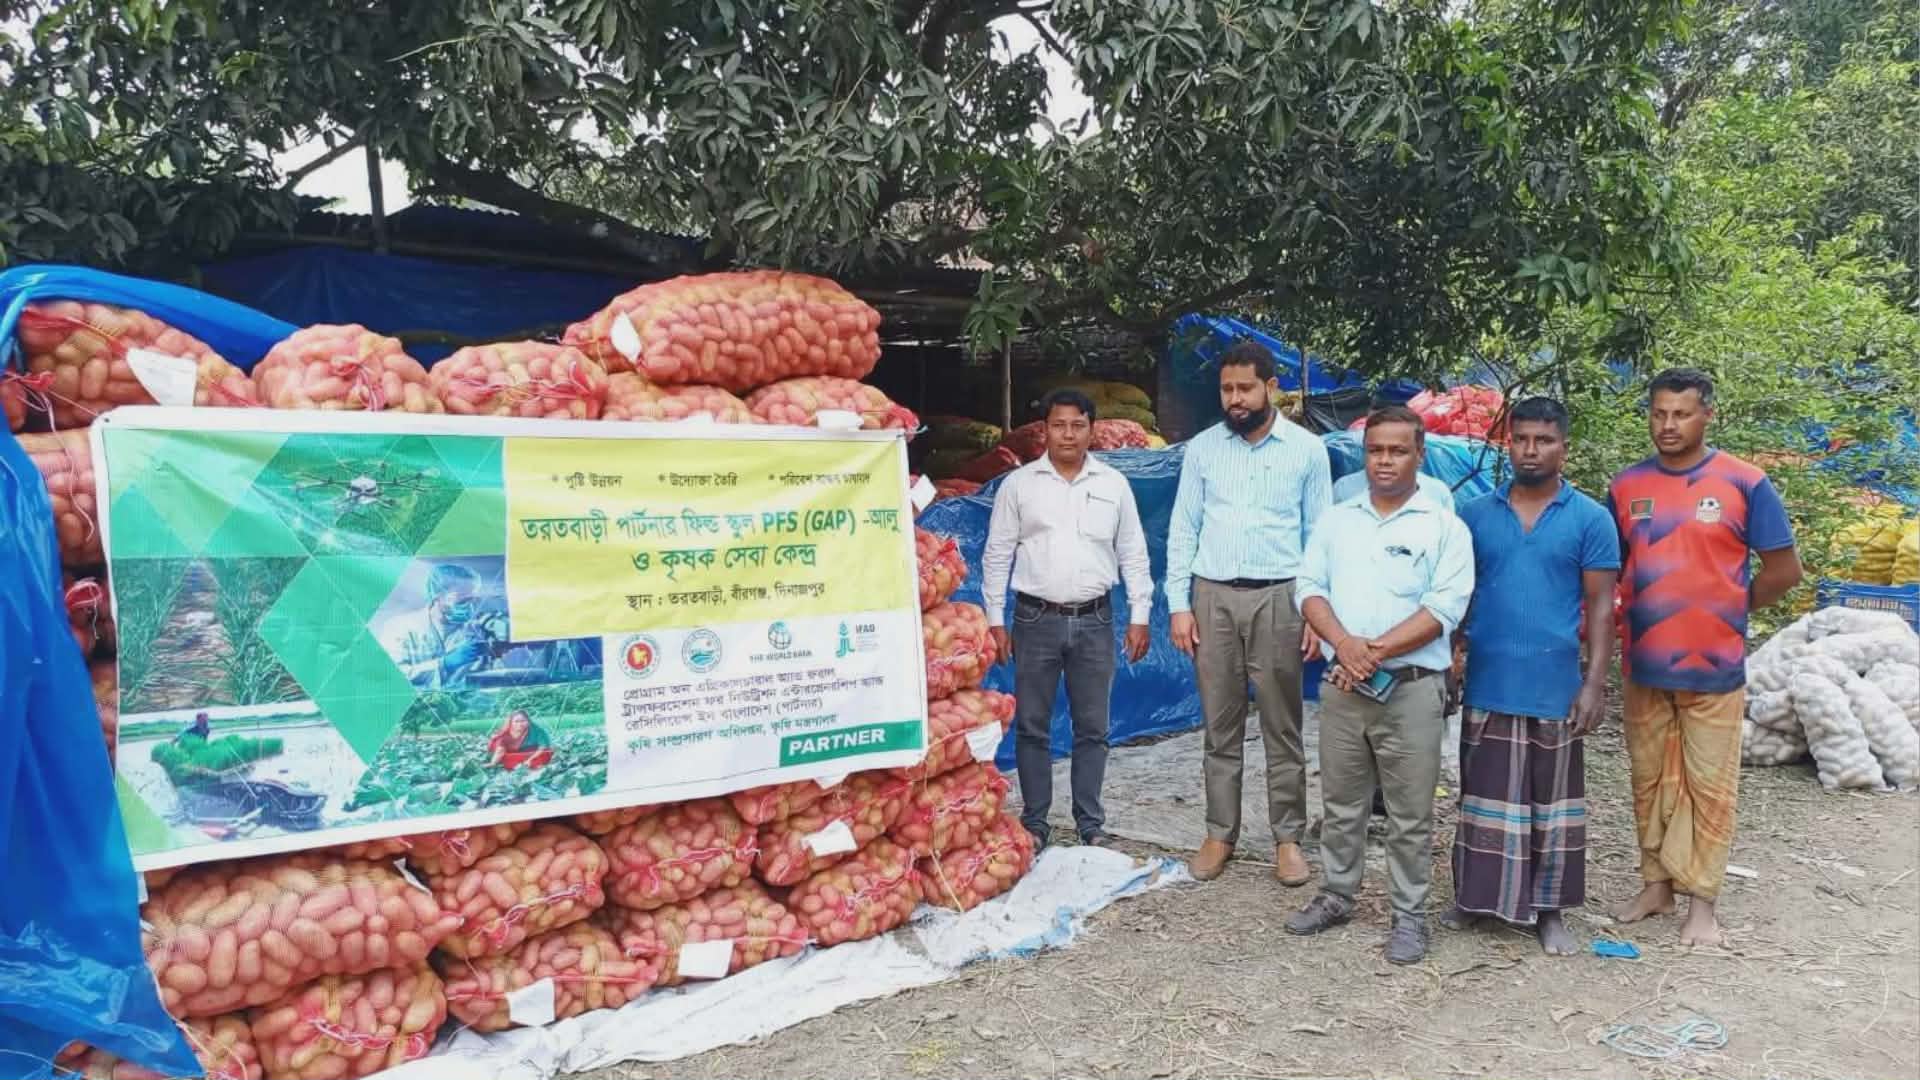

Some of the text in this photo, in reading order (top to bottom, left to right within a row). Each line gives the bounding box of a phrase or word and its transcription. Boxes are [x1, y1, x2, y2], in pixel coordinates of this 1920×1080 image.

[520, 509, 609, 543] তরতবাড়ী
[616, 508, 678, 538] পার্টনার
[724, 514, 756, 539] স্কুল
[762, 511, 798, 533] PFS
[804, 509, 856, 536] (GAP)
[632, 544, 817, 580] ও কৃষক সেবা কেন্দ্র
[788, 728, 886, 756] PARTNER
